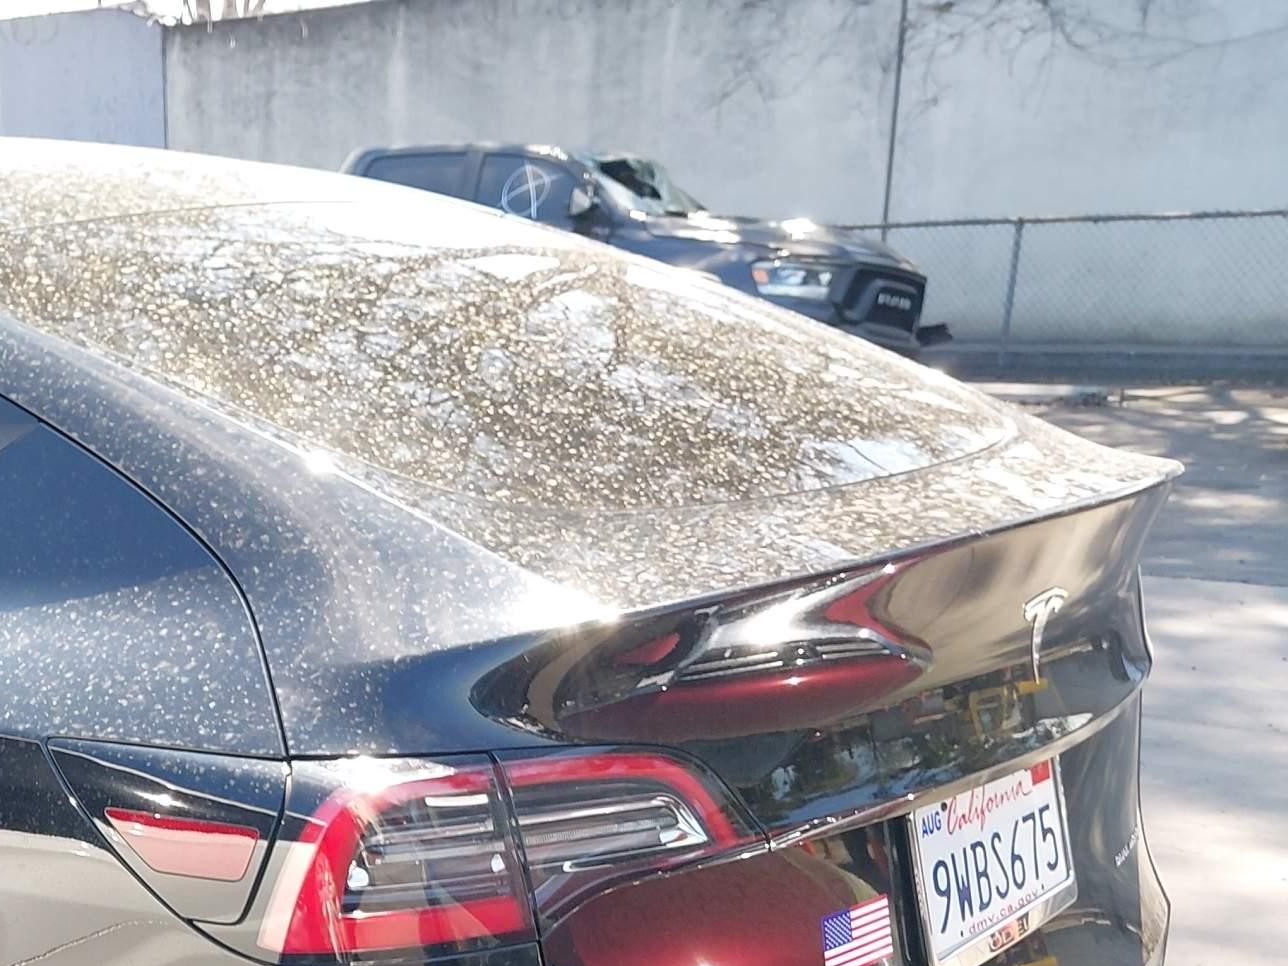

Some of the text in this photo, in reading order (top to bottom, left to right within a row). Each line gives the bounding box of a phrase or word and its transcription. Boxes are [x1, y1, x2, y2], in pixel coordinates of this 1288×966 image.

[921, 810, 943, 839] AUG
[947, 780, 1033, 836] California
[932, 803, 1059, 934] 9WBS675
[968, 888, 1039, 936] dmv.ca.gov
